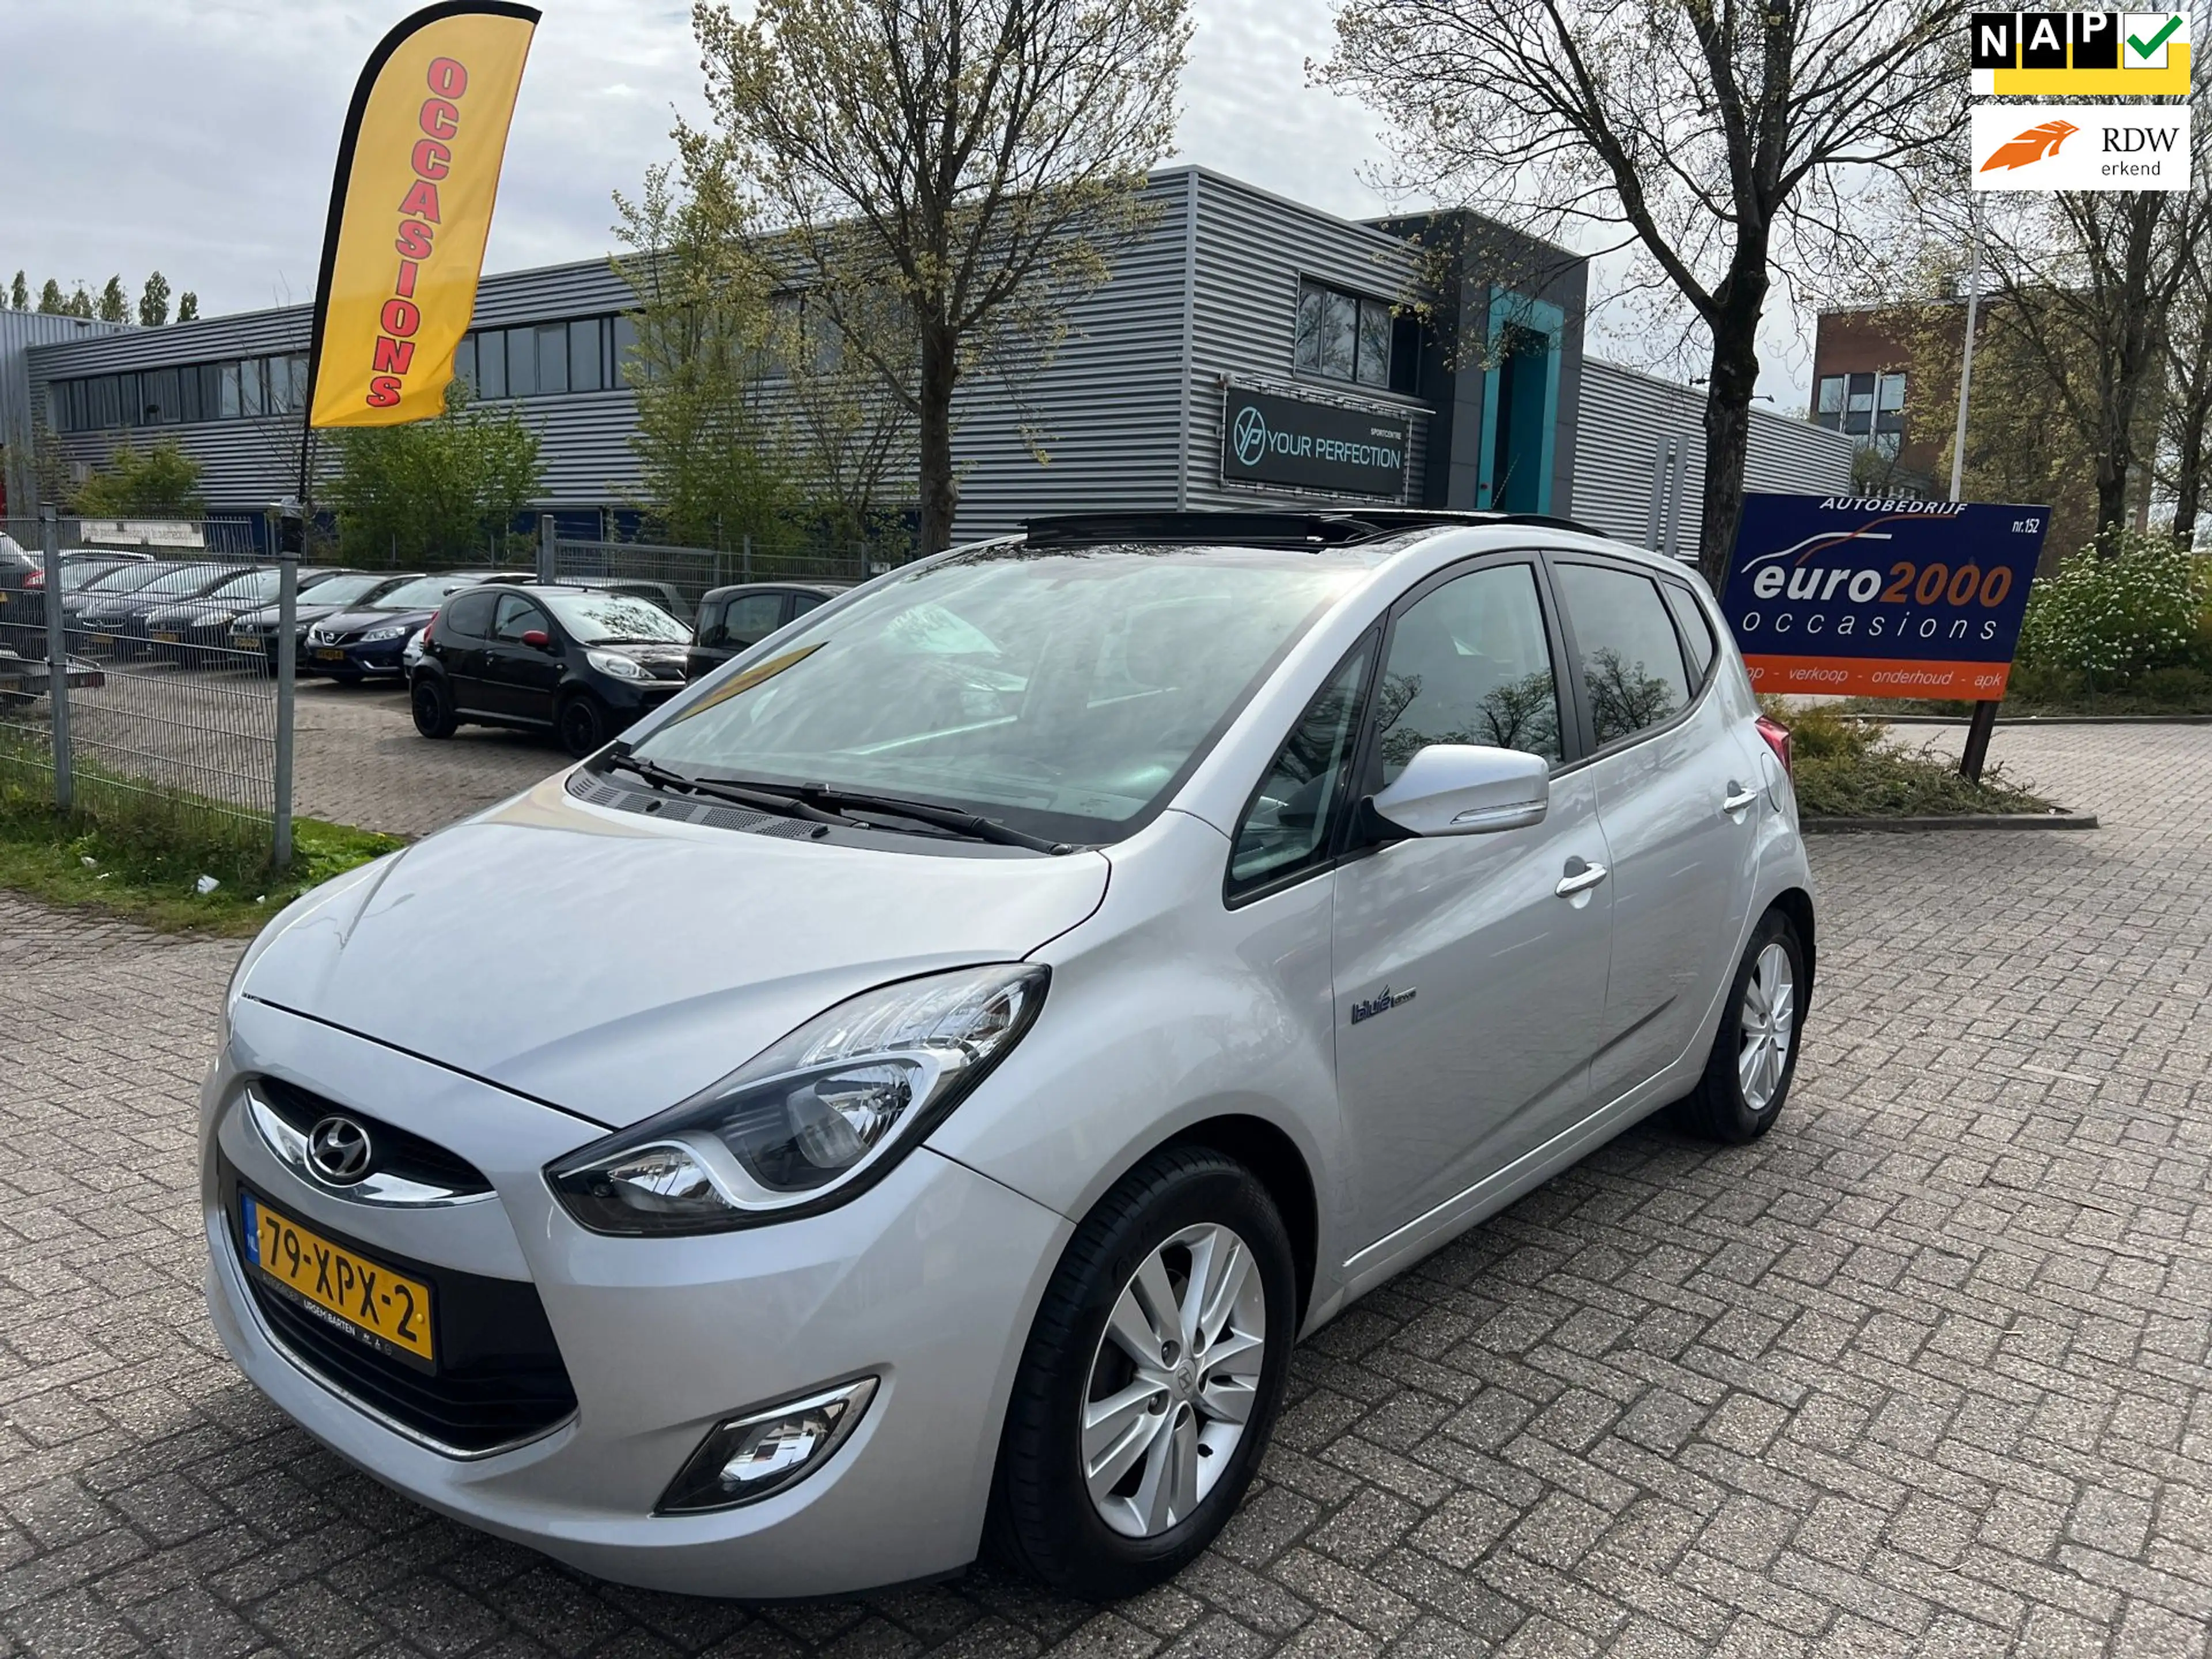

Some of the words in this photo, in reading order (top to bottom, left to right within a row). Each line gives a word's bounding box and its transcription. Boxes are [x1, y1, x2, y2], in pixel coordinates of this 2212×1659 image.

[365, 56, 468, 408] OCCASIONS
[1267, 430, 1312, 458] YOUR
[1315, 438, 1401, 469] PERFECTION
[1820, 497, 1968, 515] AUTOBEDRIJF
[2012, 518, 2040, 533] nr.152
[1753, 563, 2013, 607] euro2000
[1743, 612, 1998, 640] occasions
[1789, 666, 1849, 684] verkoop
[1872, 669, 1954, 685] onderhoud
[1974, 673, 2003, 689] apk
[265, 1215, 418, 1343] 79-XPX-2
